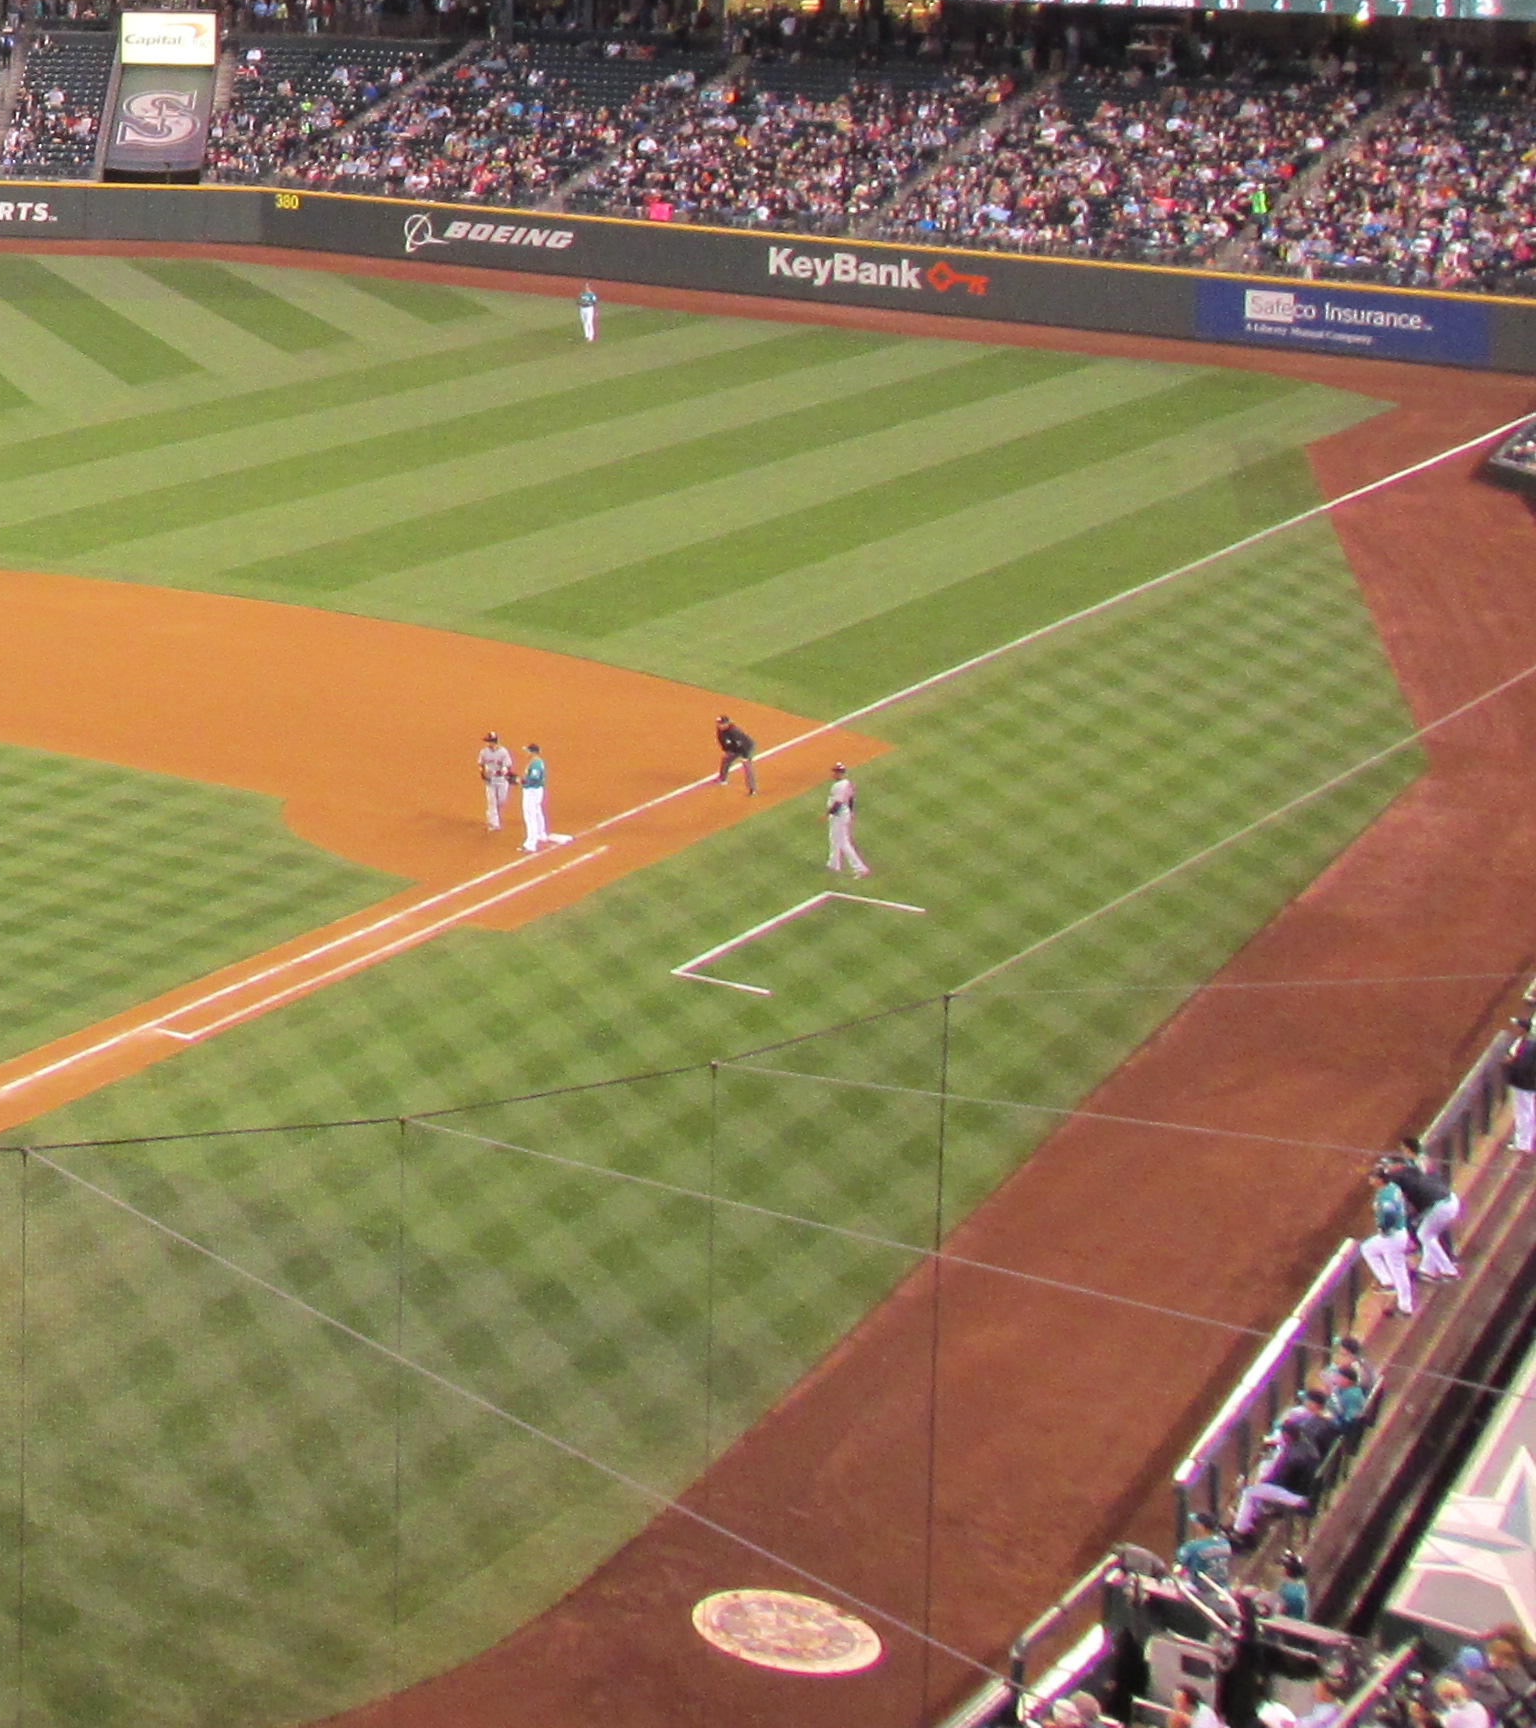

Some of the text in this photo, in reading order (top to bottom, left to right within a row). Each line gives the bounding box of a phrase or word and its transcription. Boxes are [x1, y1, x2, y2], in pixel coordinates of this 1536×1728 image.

[124, 34, 182, 46] Capital
[275, 194, 299, 209] 380
[444, 221, 575, 249] BOEING
[768, 246, 922, 290] KeyBank
[1252, 295, 1422, 330] Safeco Insurance
